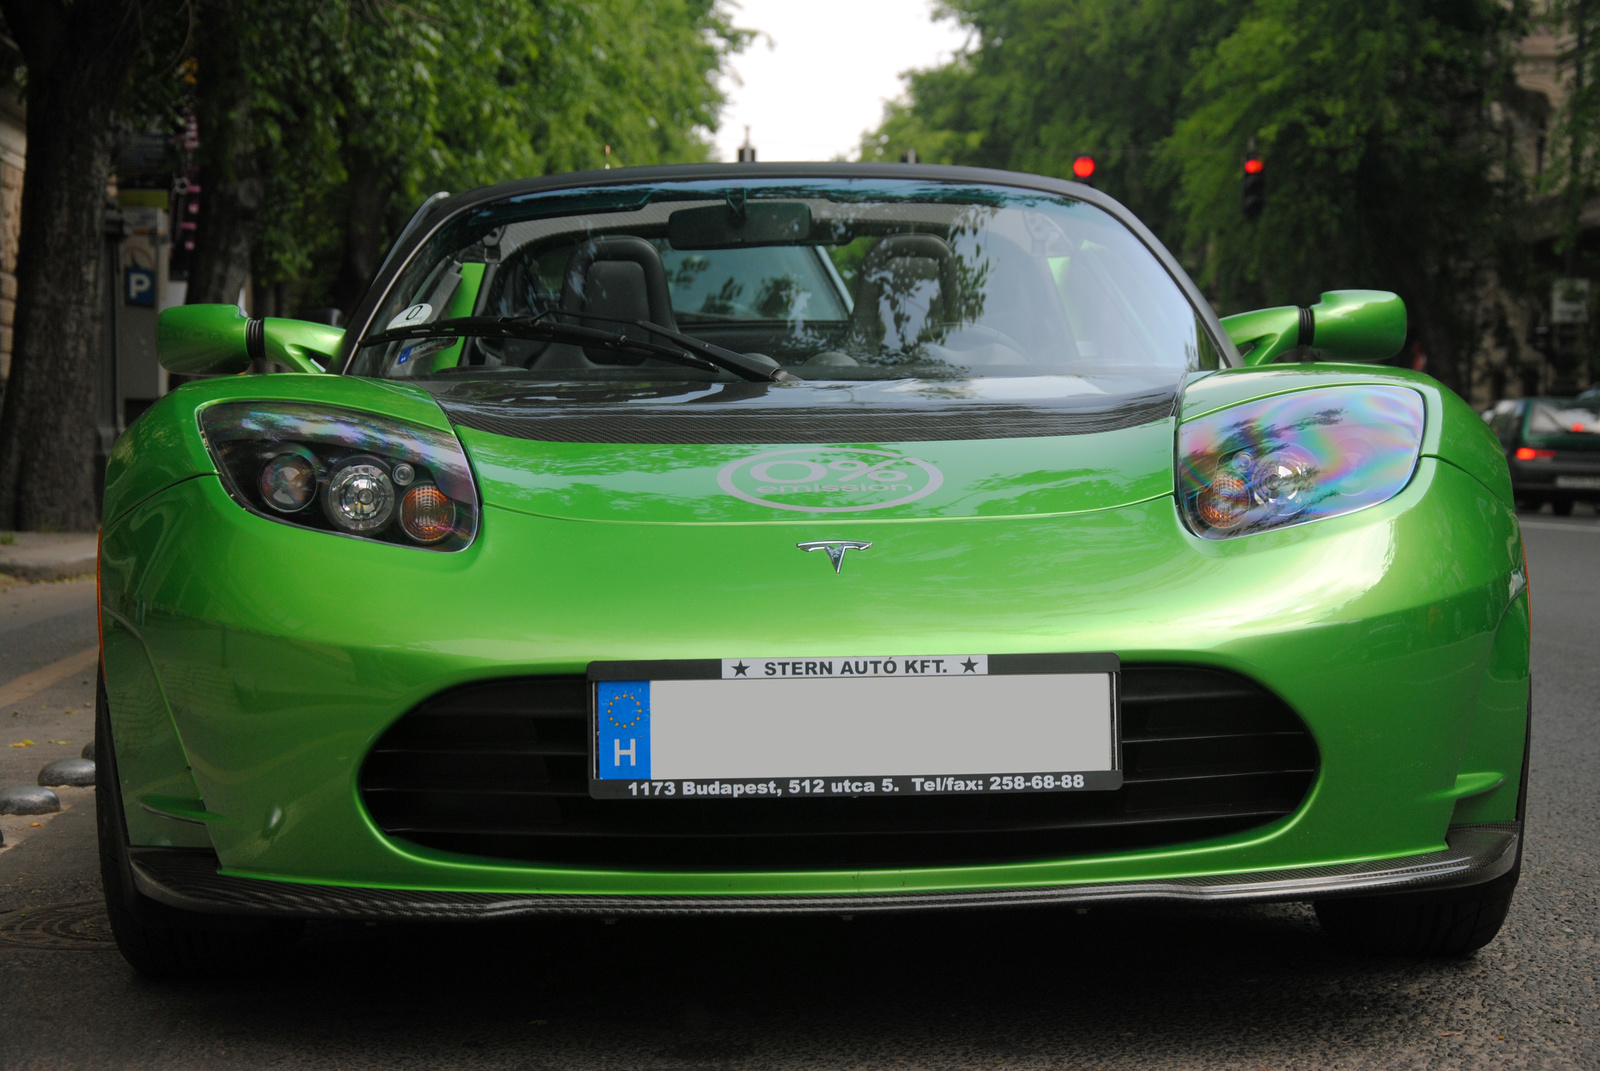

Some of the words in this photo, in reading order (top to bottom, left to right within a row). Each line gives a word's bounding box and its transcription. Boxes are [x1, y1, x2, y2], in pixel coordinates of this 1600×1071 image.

[129, 272, 152, 299] P
[750, 460, 908, 483] 0%
[756, 483, 913, 493] emission
[764, 660, 833, 676] STERN
[840, 657, 898, 675] AUTÓ
[904, 659, 948, 674] KFT.
[614, 738, 636, 767] H
[628, 781, 677, 796] 1173
[682, 780, 782, 798] Budapest,
[788, 779, 825, 794] 512
[831, 779, 876, 793] utca
[881, 778, 900, 793] 5.
[911, 776, 984, 792] Tel/fax:
[989, 774, 1085, 791] 258-68-88
